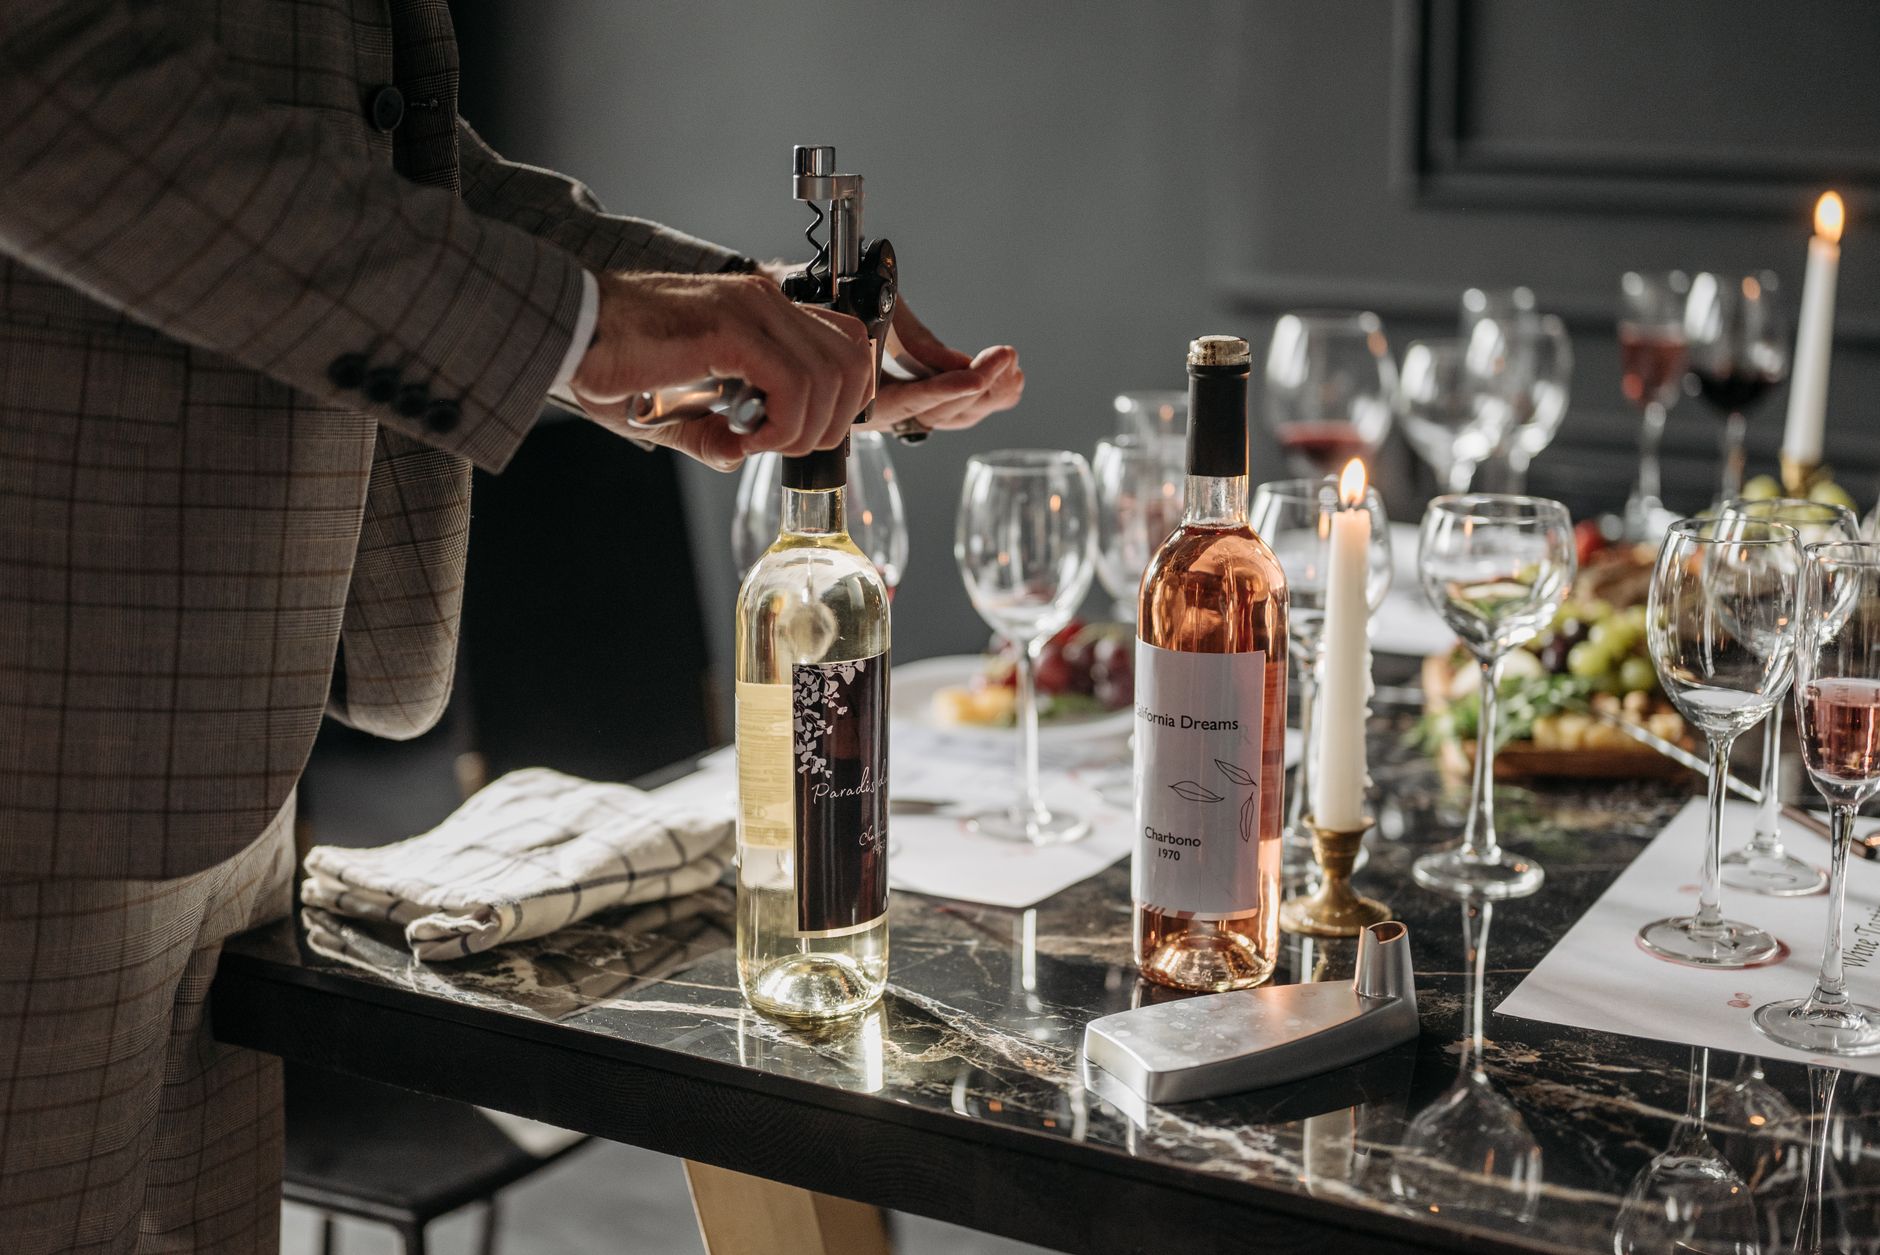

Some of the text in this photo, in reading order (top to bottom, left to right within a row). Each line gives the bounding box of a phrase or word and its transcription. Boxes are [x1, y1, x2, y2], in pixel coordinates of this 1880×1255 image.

[1179, 714, 1239, 731] Dreams
[811, 766, 876, 805] Paradis
[1144, 826, 1202, 847] Charbono
[1158, 847, 1181, 861] 1970
[1842, 938, 1880, 968] Wine
